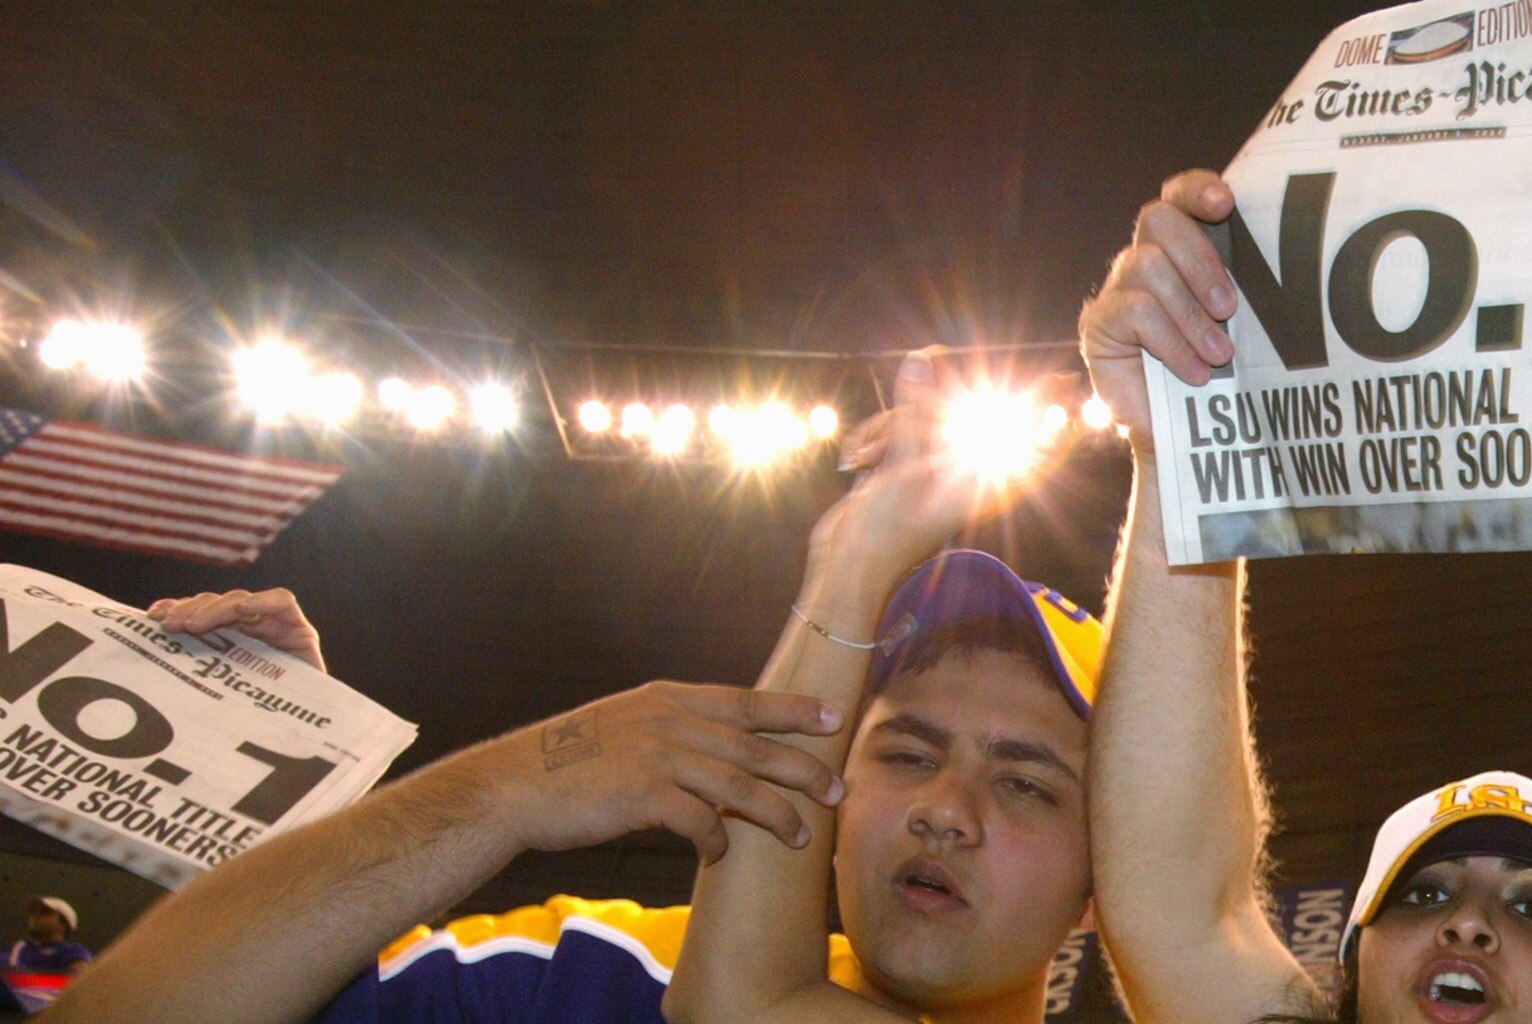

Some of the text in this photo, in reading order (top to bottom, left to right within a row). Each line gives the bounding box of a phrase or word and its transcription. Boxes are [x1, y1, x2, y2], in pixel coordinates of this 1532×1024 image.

[1334, 33, 1386, 69] DOME
[1267, 97, 1302, 129] he
[1187, 396, 1261, 448] LSU
[1262, 382, 1343, 443] WINS
[1352, 367, 1519, 436] NATIONAL
[1191, 446, 1289, 503] WITH
[1290, 441, 1351, 500] WIN
[1360, 430, 1444, 494] OVER
[229, 646, 287, 681] EDITION
[4, 722, 262, 847] NATIONAL TITLE
[76, 789, 240, 868] SOONERS
